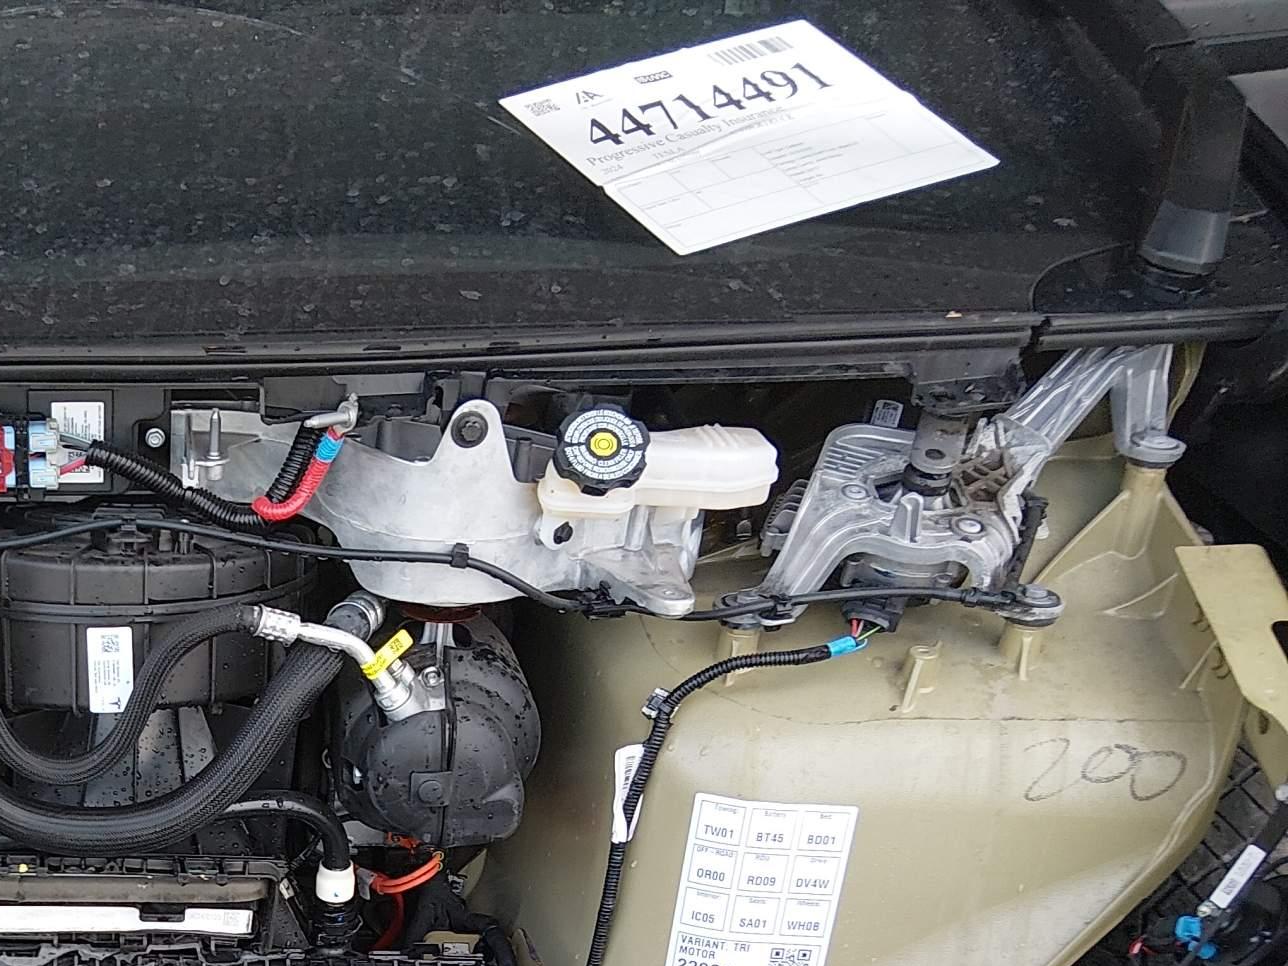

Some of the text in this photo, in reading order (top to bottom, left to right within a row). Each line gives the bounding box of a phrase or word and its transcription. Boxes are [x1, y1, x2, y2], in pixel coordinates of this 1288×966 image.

[589, 62, 835, 145] 44714491
[586, 134, 663, 166] Progressive
[665, 119, 722, 145] Casualty
[722, 105, 784, 127] Insurance
[1024, 737, 1188, 801] 200
[703, 824, 734, 839] TW01
[756, 832, 784, 843] BT45
[807, 834, 836, 845] BD01
[747, 875, 776, 887] RD09
[795, 877, 830, 889] DV4W
[691, 910, 715, 924] IC05
[738, 918, 767, 929] SA01
[678, 945, 716, 960] MOTOR
[733, 943, 751, 952] TRI
